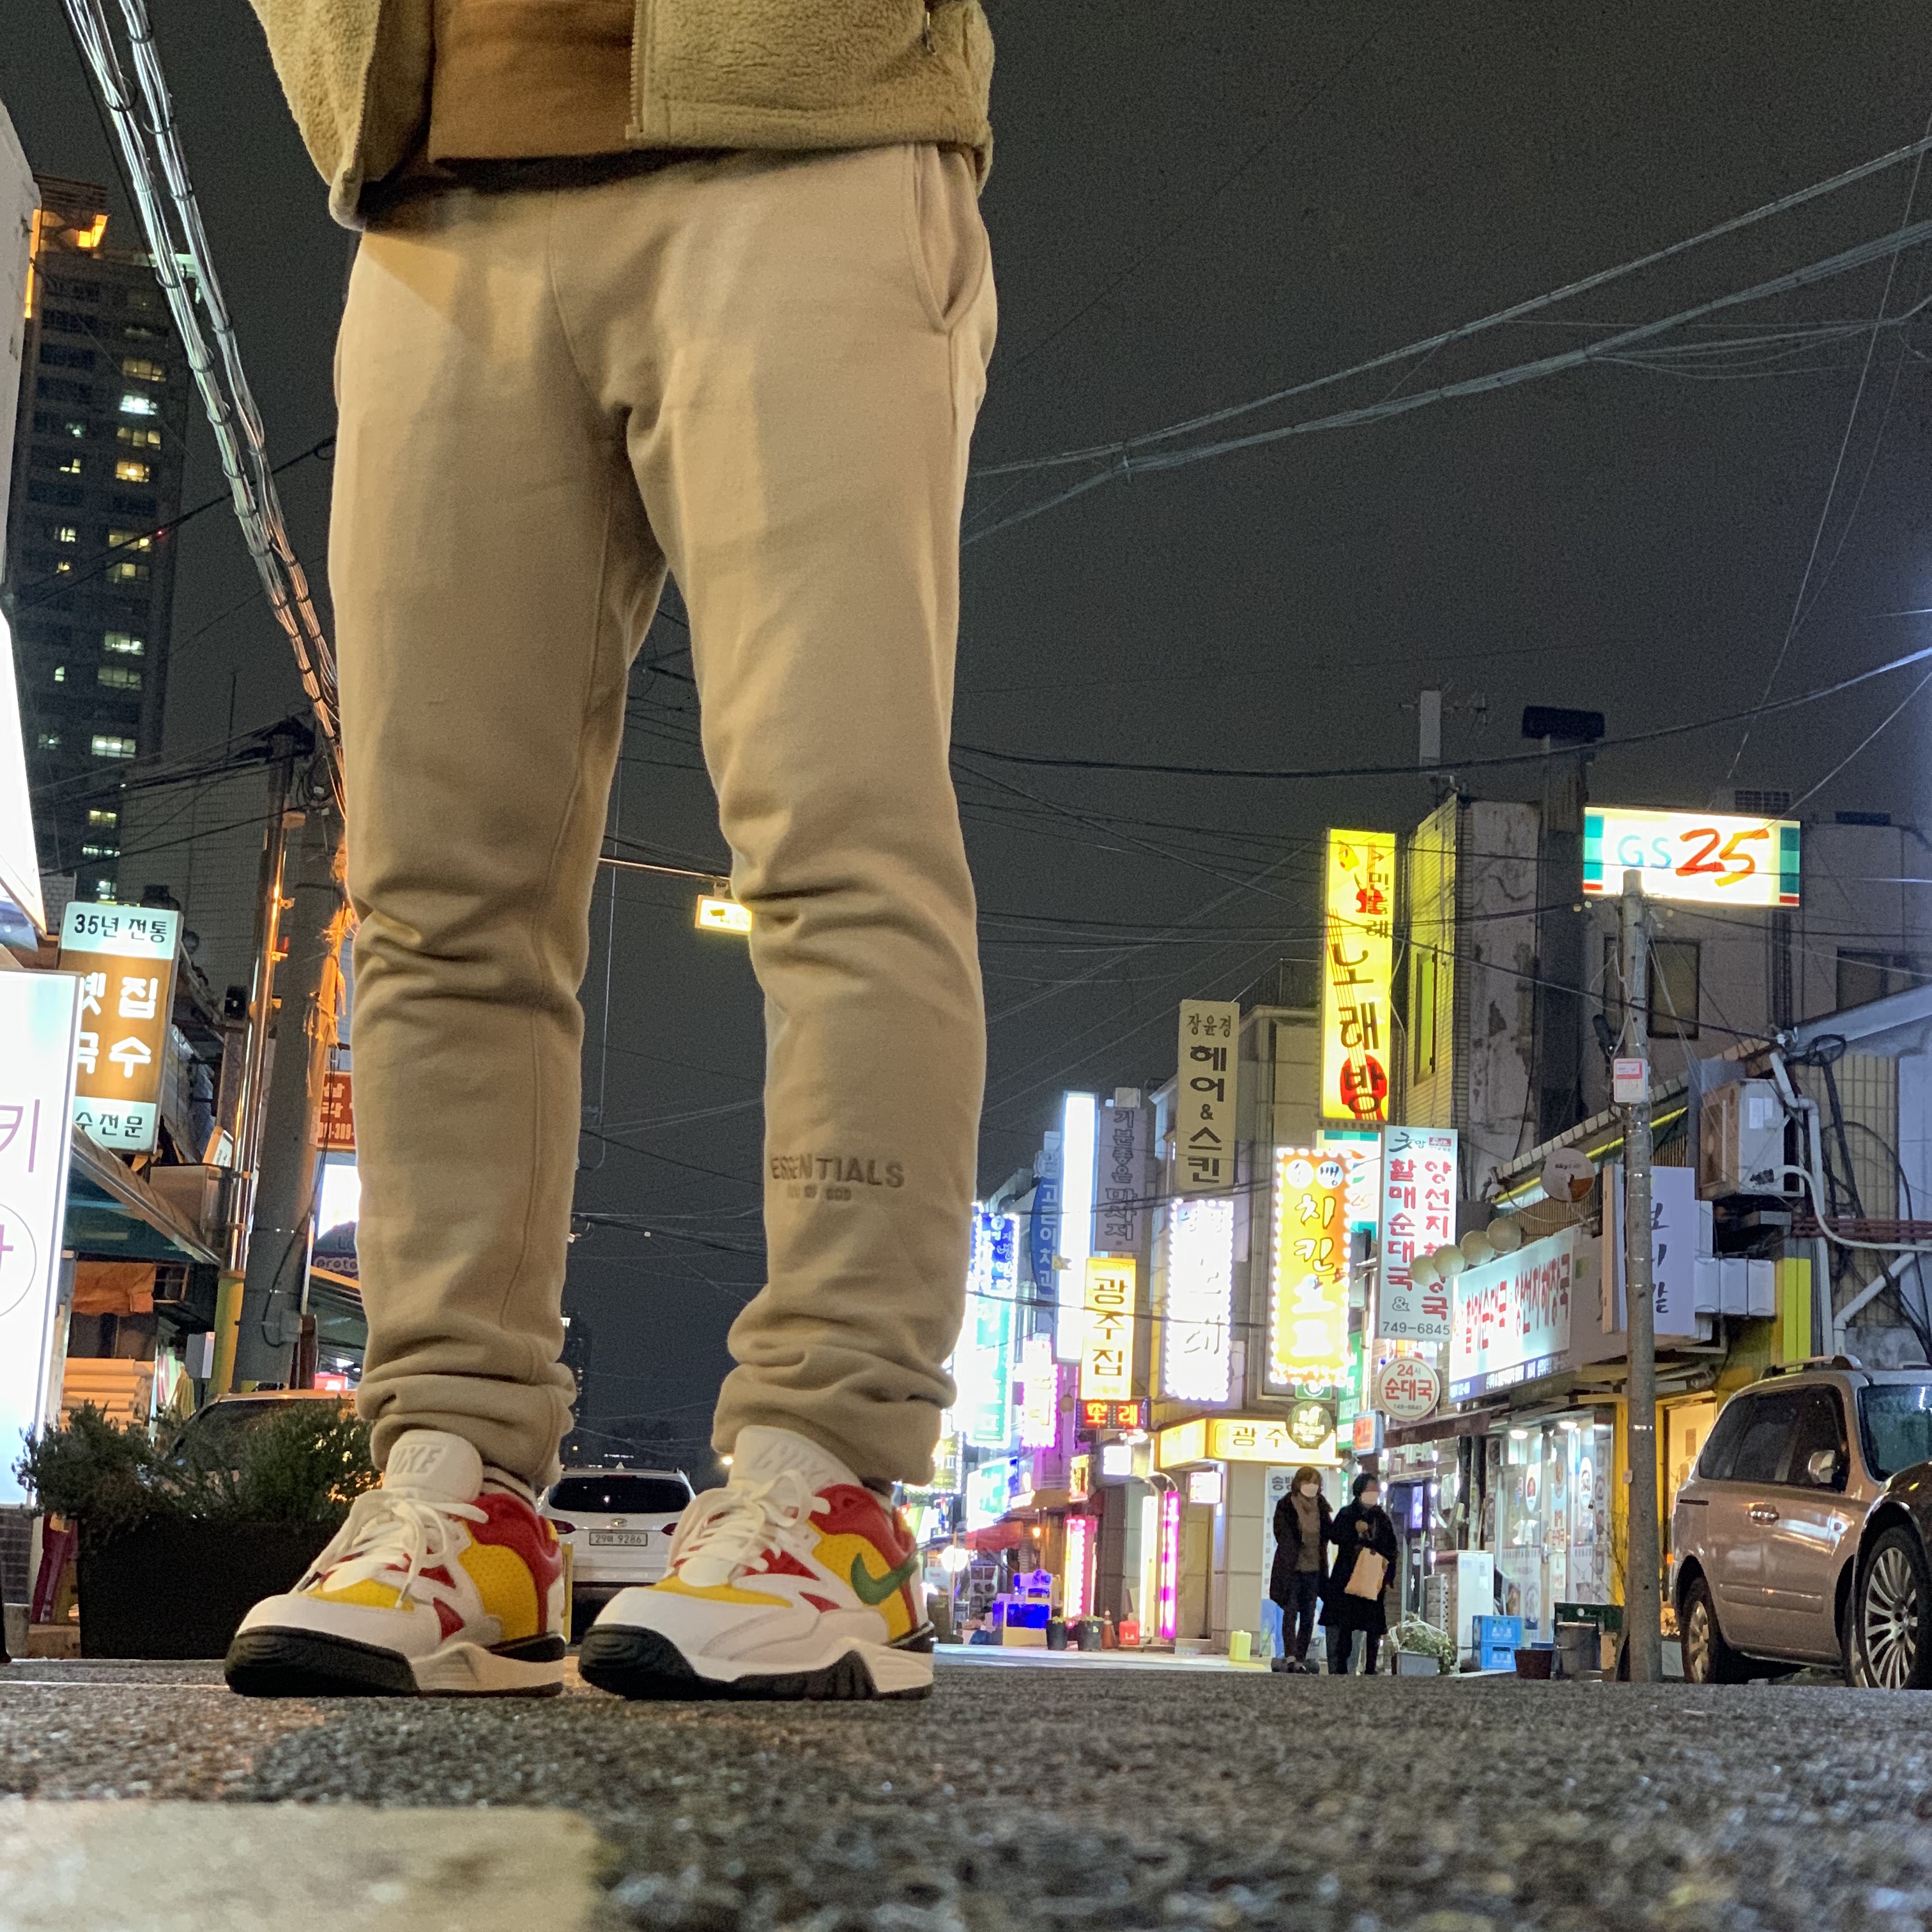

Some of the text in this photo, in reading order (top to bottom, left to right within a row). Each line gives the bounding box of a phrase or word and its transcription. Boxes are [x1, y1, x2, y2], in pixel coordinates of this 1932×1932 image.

[1618, 828, 1770, 887] GS25
[74, 914, 167, 943] 35년 전통
[1187, 1013, 1232, 1038] 장윤경
[1333, 942, 1384, 1114] 노래방
[1190, 1045, 1227, 1102] 헤어
[1200, 1103, 1214, 1120] &
[1187, 1126, 1222, 1183] 스킨
[1092, 1278, 1129, 1377] 광주집
[1383, 1321, 1451, 1336] 749-6845
[1384, 1377, 1433, 1402] 순대국
[617, 1534, 642, 1544] 9286
